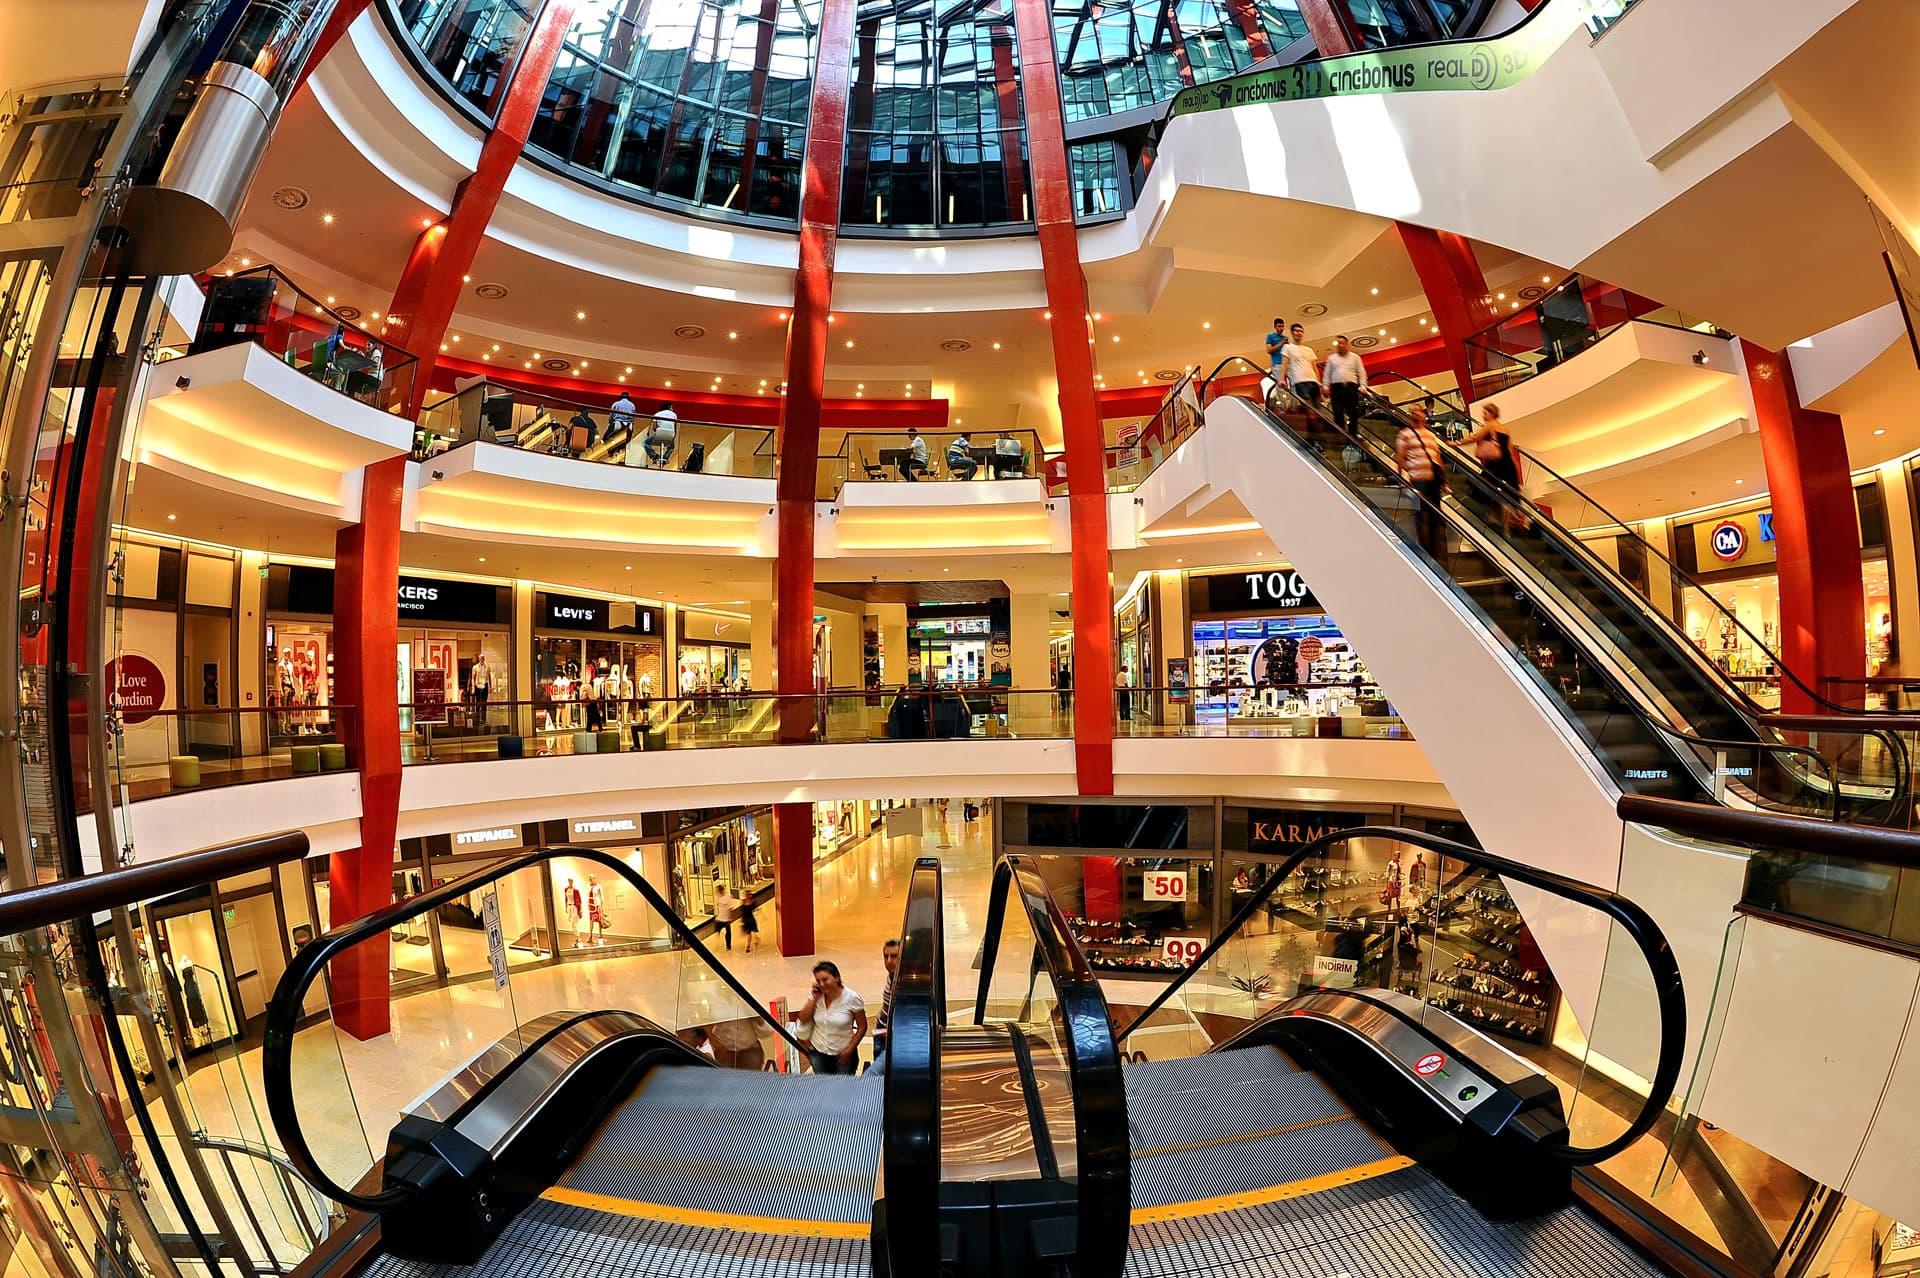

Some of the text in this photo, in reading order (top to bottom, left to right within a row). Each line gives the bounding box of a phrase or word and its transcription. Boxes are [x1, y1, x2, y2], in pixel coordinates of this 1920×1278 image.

[1236, 78, 1287, 103] cinebonus
[1292, 63, 1322, 99] 3D
[1329, 61, 1415, 92] cinebonus
[1503, 50, 1529, 74] 3D
[1280, 597, 1301, 607] 1937
[121, 672, 147, 688] Love
[574, 818, 637, 833] STEFANEL
[456, 828, 518, 845] STEFANEL
